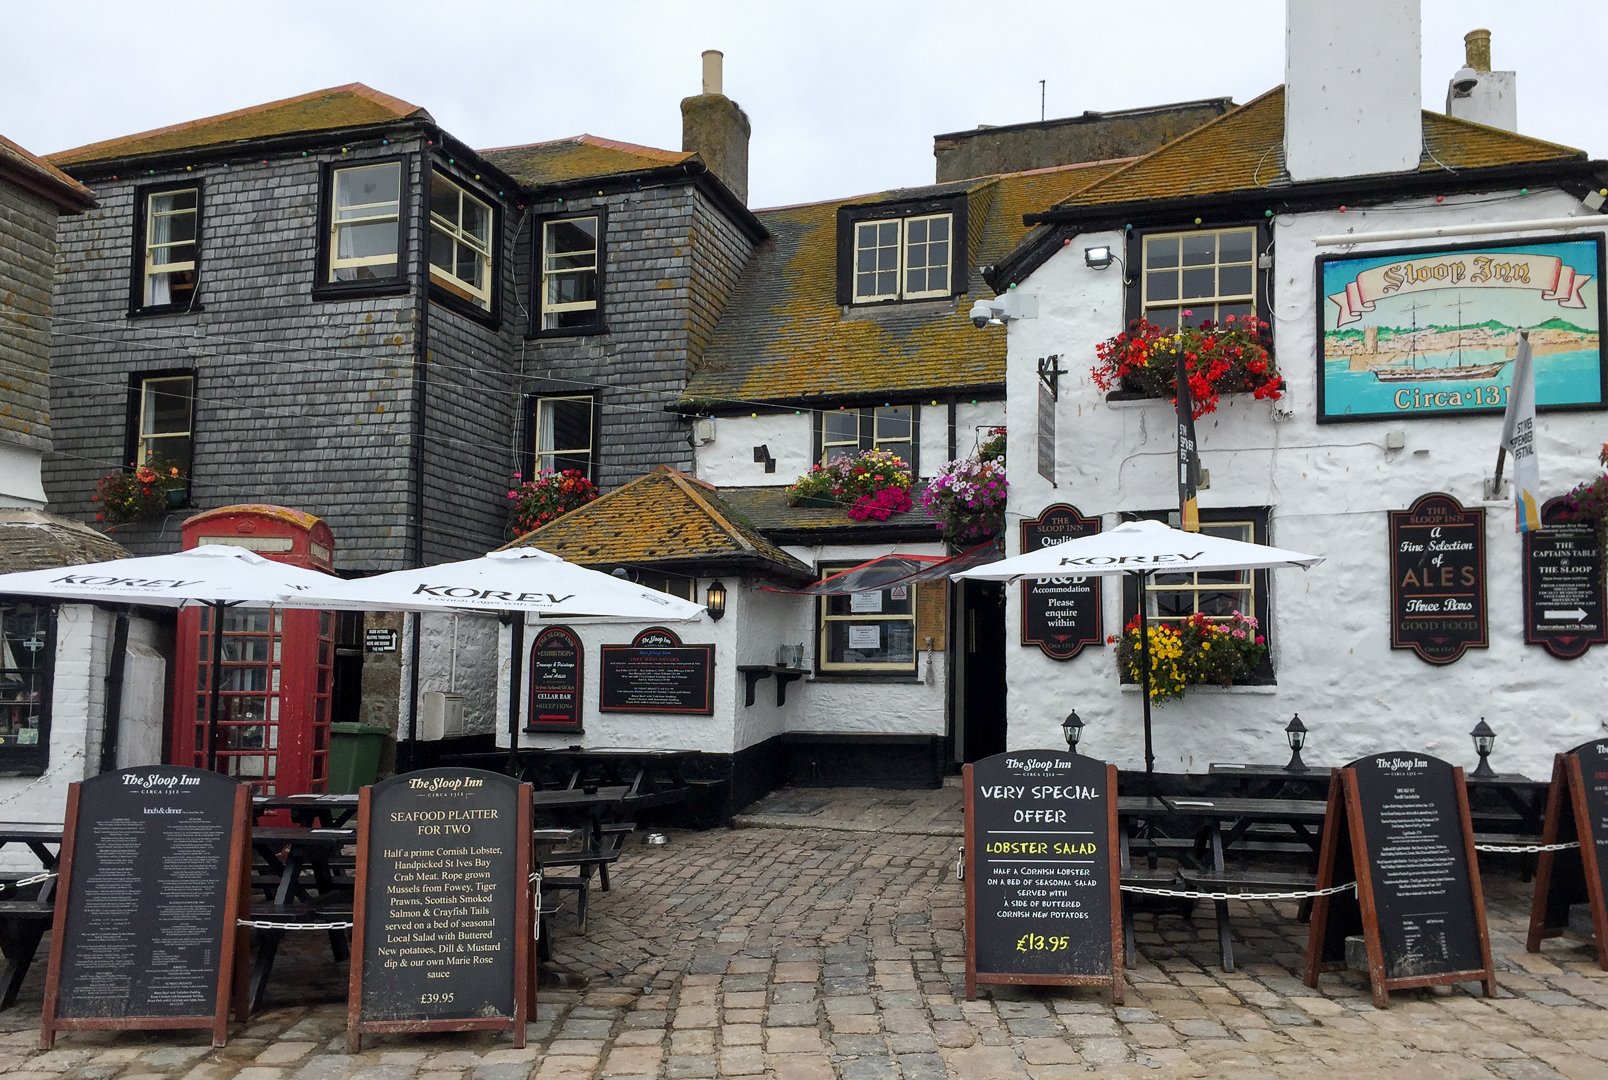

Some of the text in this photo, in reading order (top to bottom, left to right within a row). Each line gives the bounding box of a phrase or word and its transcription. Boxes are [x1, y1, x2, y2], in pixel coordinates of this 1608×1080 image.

[1383, 256, 1531, 294] Sloop Inn
[1400, 540, 1473, 552] Fine Selection
[1059, 552, 1204, 566] KOREV
[1432, 554, 1443, 567] of
[50, 575, 206, 588] KOREV
[1402, 566, 1475, 587] ALES
[412, 584, 576, 603] KOREV
[1032, 586, 1090, 594] Accommodation
[1406, 598, 1472, 611] Three Bars
[1045, 610, 1077, 618] enquire
[1401, 621, 1477, 630] GOOD FOOD
[538, 636, 547, 647] THE
[565, 635, 574, 647] INN
[1006, 759, 1071, 771] The Sloop Inn
[1376, 758, 1427, 771] The Sloop Inn
[122, 774, 200, 788] The Sloop Inn
[409, 777, 483, 791] The Sloop Inn
[981, 786, 1099, 800] VERY SPECIAL
[391, 810, 498, 821] SEAFOOD PLATTER
[1014, 810, 1067, 823] OFFER
[418, 824, 471, 835] FOR TWO
[384, 849, 403, 857] Half
[411, 849, 434, 858] prime
[437, 847, 468, 856] Cornish
[471, 846, 502, 855] Lobster,
[986, 842, 1097, 855] LOBSTER SALAD
[395, 861, 442, 870] Handpicked
[475, 859, 491, 868] Bay
[394, 873, 414, 881] Crab
[442, 872, 462, 881] Rope
[465, 872, 490, 880] grown
[1021, 867, 1054, 875] CORNISH
[387, 882, 497, 893] Mussels from Fowey, Tiger
[390, 894, 492, 906] Prawns, Scottish Smoked
[390, 910, 420, 918] Salmon
[433, 907, 468, 916] Crayfish
[470, 907, 489, 915] Tails
[385, 922, 411, 930] served
[434, 920, 448, 928] bed
[461, 918, 495, 927] seasonal
[387, 930, 492, 943] Local Salad with Buttered
[1017, 933, 1069, 951] £13.95
[378, 943, 500, 956] New potatoes, Dill & Mustard
[384, 960, 397, 969] dip
[400, 959, 408, 967] &
[446, 956, 470, 965] Marie
[473, 955, 493, 964] Rose
[427, 971, 450, 979] sauce
[421, 993, 454, 1004] £39.95
